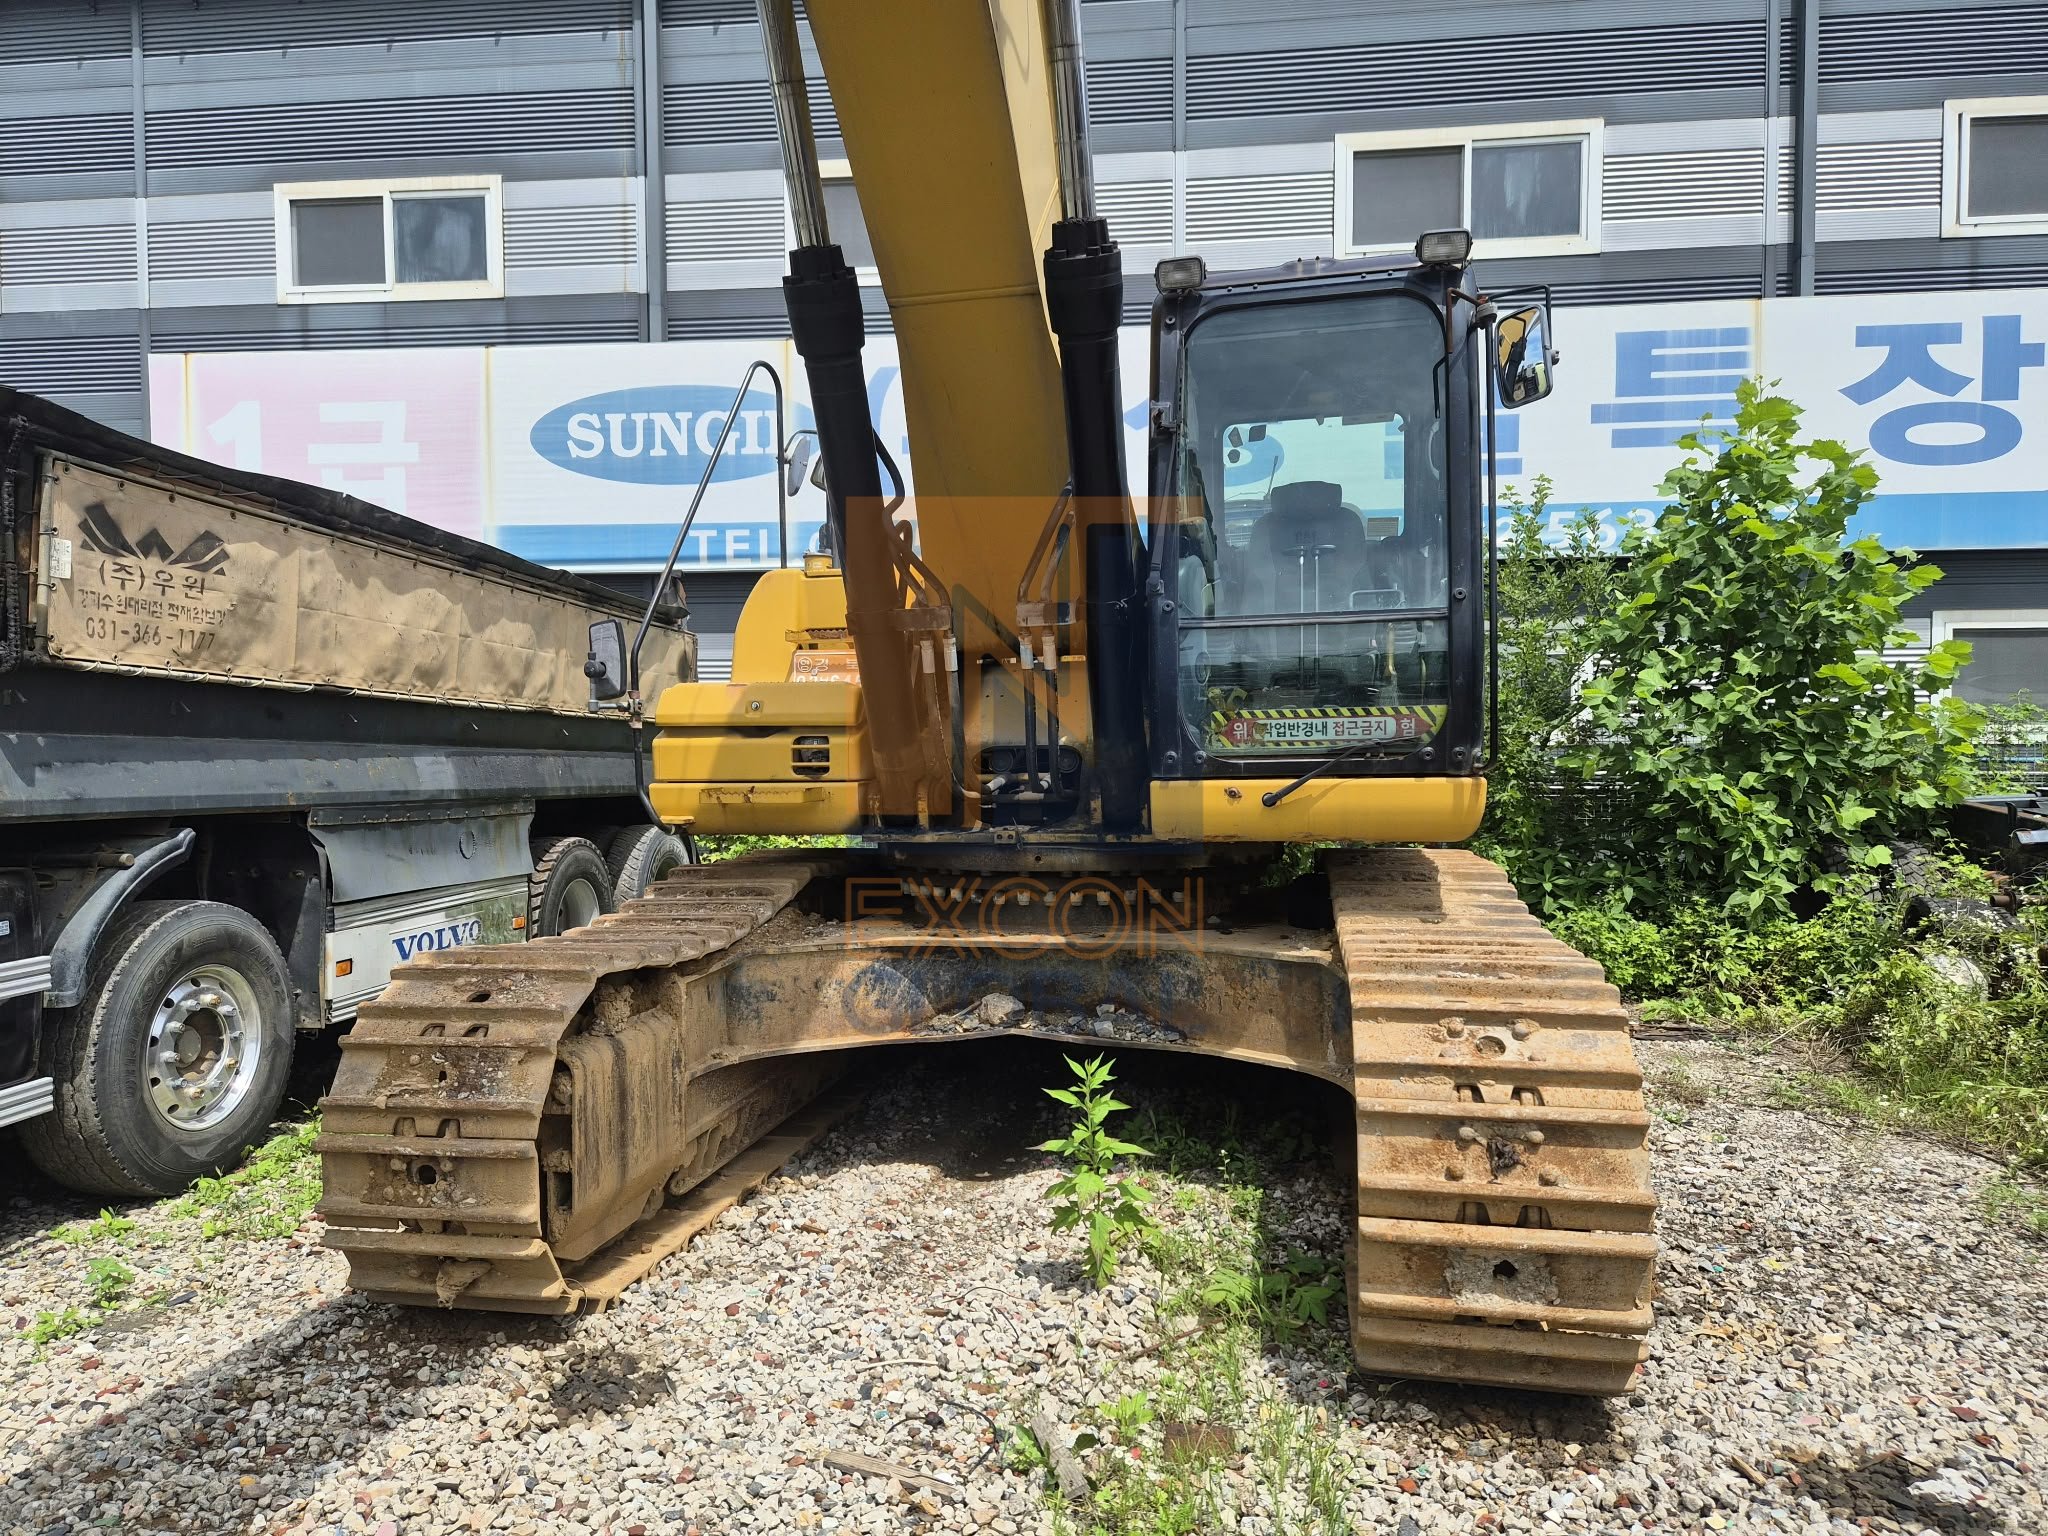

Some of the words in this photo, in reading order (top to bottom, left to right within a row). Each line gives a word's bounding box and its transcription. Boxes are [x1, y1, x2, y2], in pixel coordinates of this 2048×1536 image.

[689, 528, 779, 564] TEL
[1332, 719, 1388, 736] 접근금지
[392, 919, 481, 961] VOLVO
